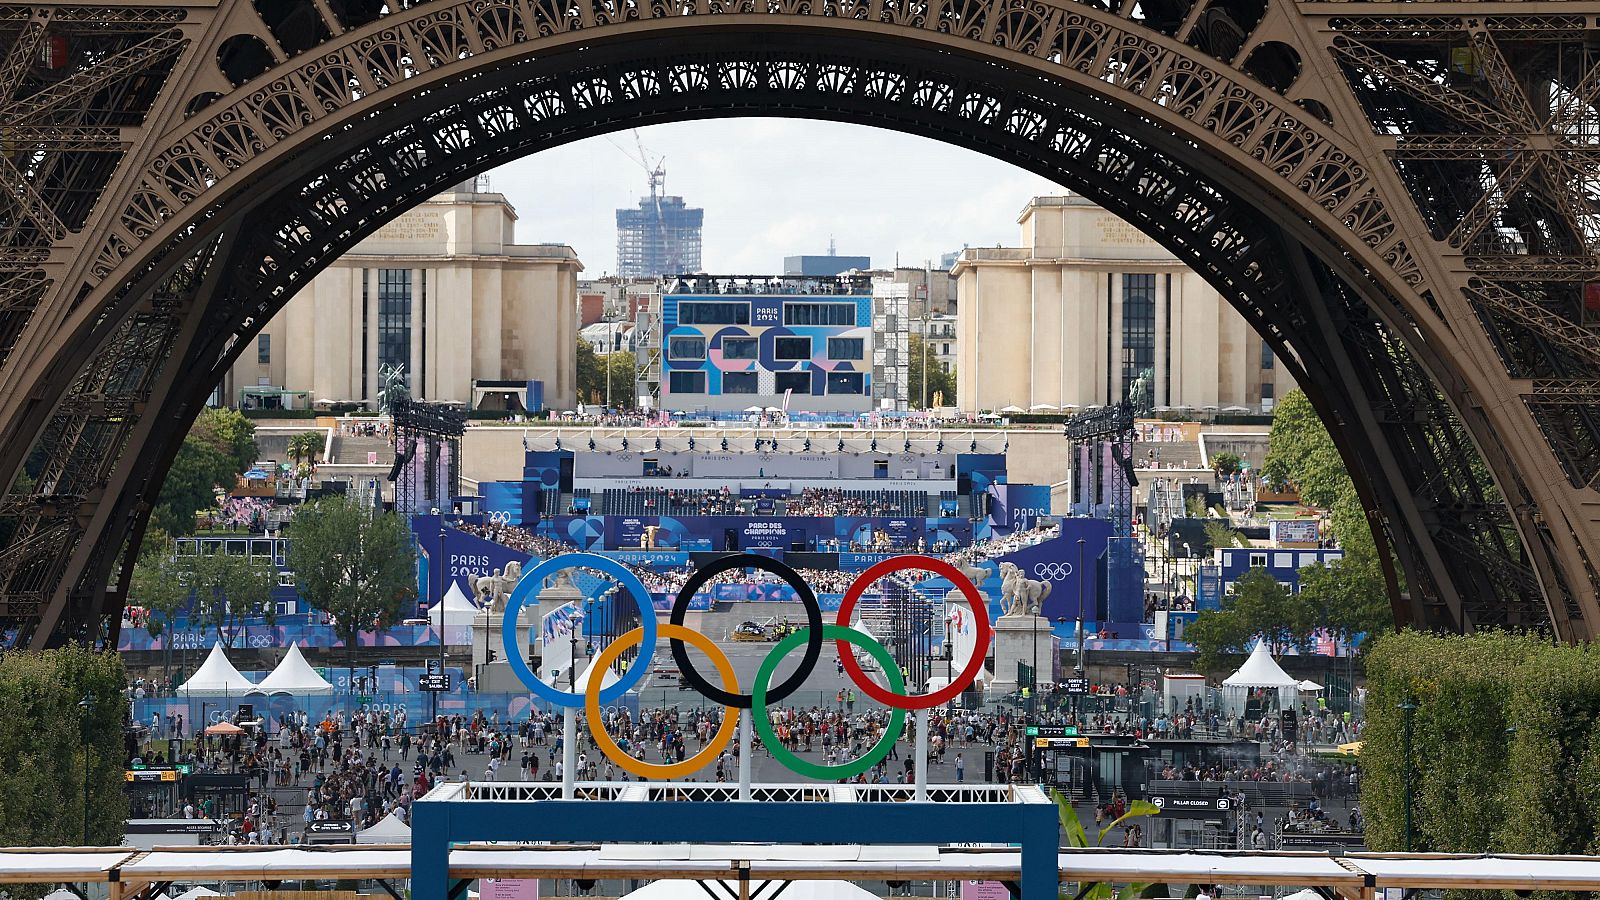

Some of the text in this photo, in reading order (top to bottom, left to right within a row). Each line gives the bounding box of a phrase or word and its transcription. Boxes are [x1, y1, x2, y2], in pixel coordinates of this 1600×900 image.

[743, 528, 787, 536] CHAMPIONS
[650, 554, 676, 562] 2024
[450, 566, 489, 577] 2024
